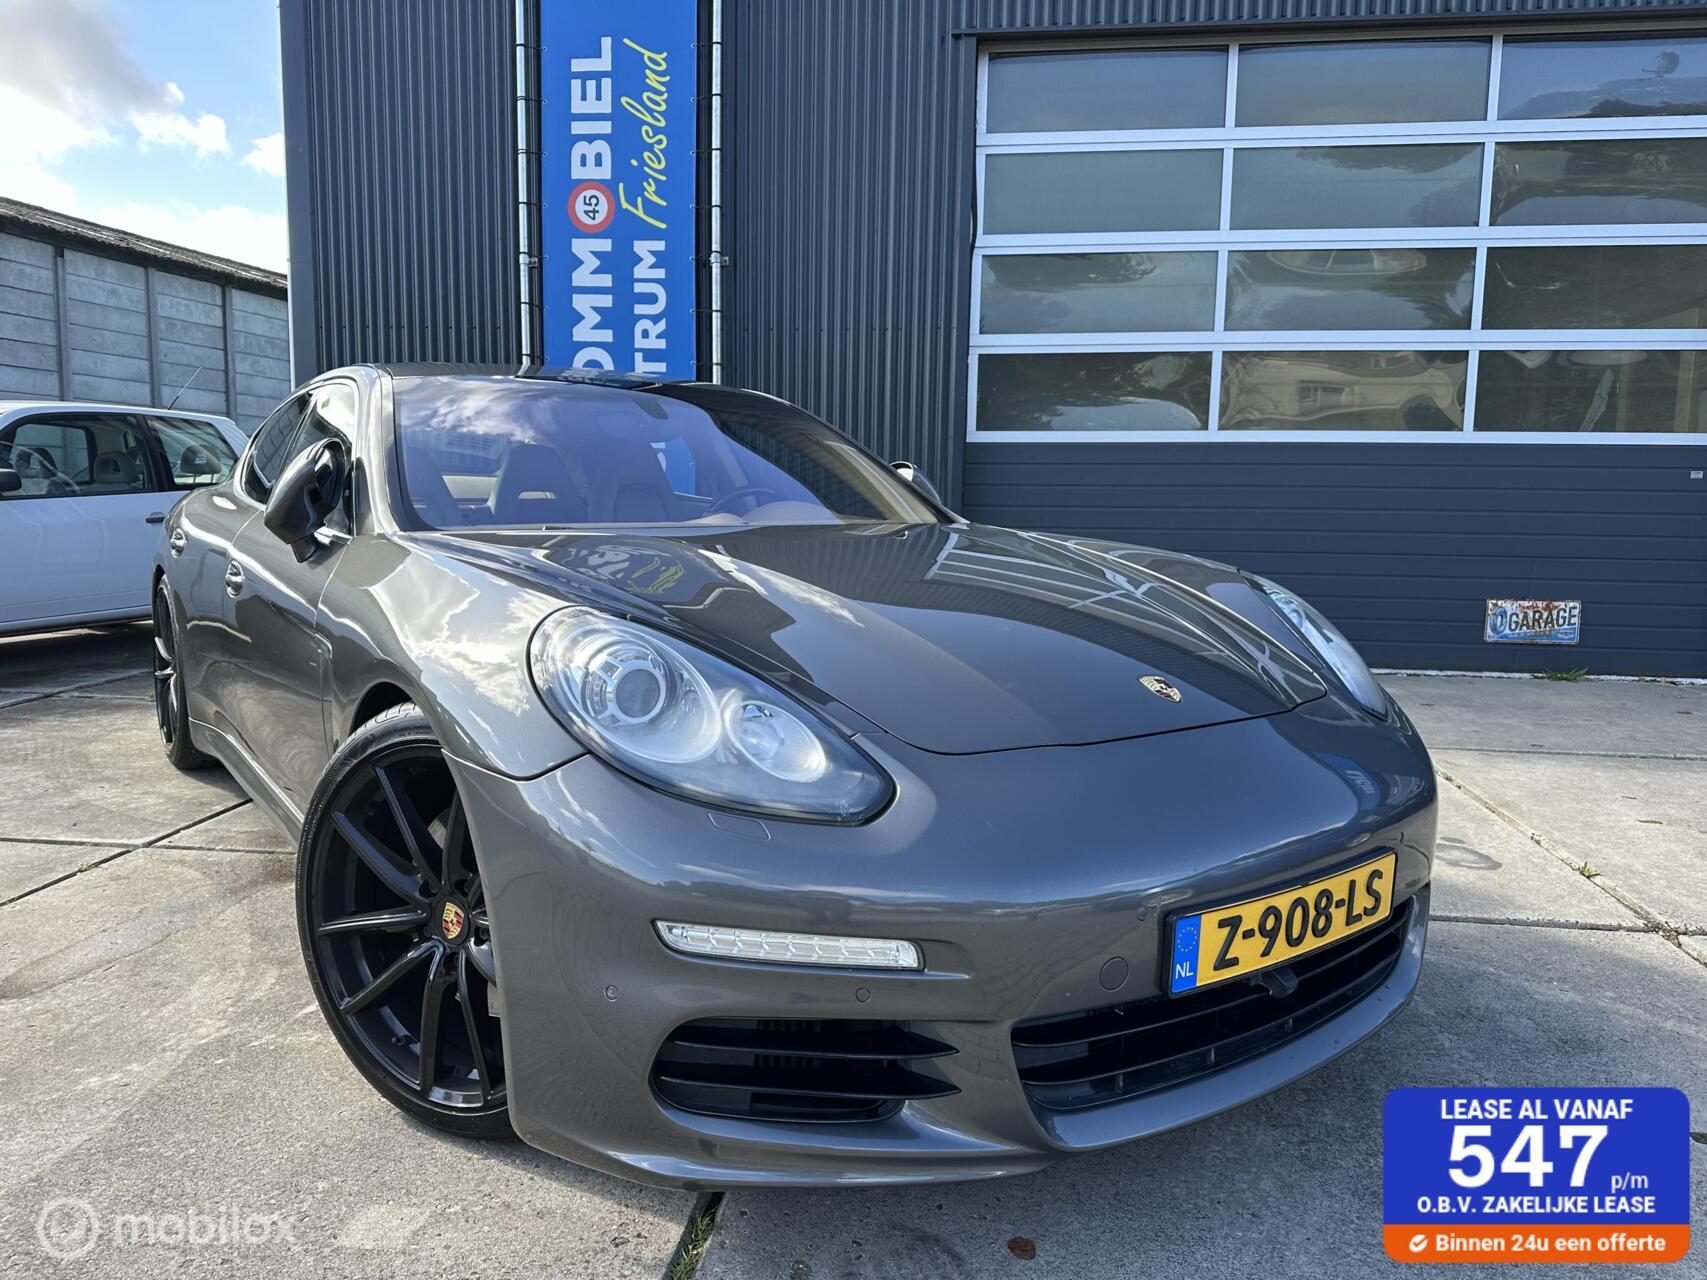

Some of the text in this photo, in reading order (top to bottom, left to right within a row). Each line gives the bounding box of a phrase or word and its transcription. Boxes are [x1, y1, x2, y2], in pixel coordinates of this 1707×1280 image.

[619, 37, 670, 373] TRUM Friesland
[1508, 606, 1577, 631] GARAGE
[1213, 869, 1383, 971] Z-908-LS
[1175, 961, 1194, 979] NL
